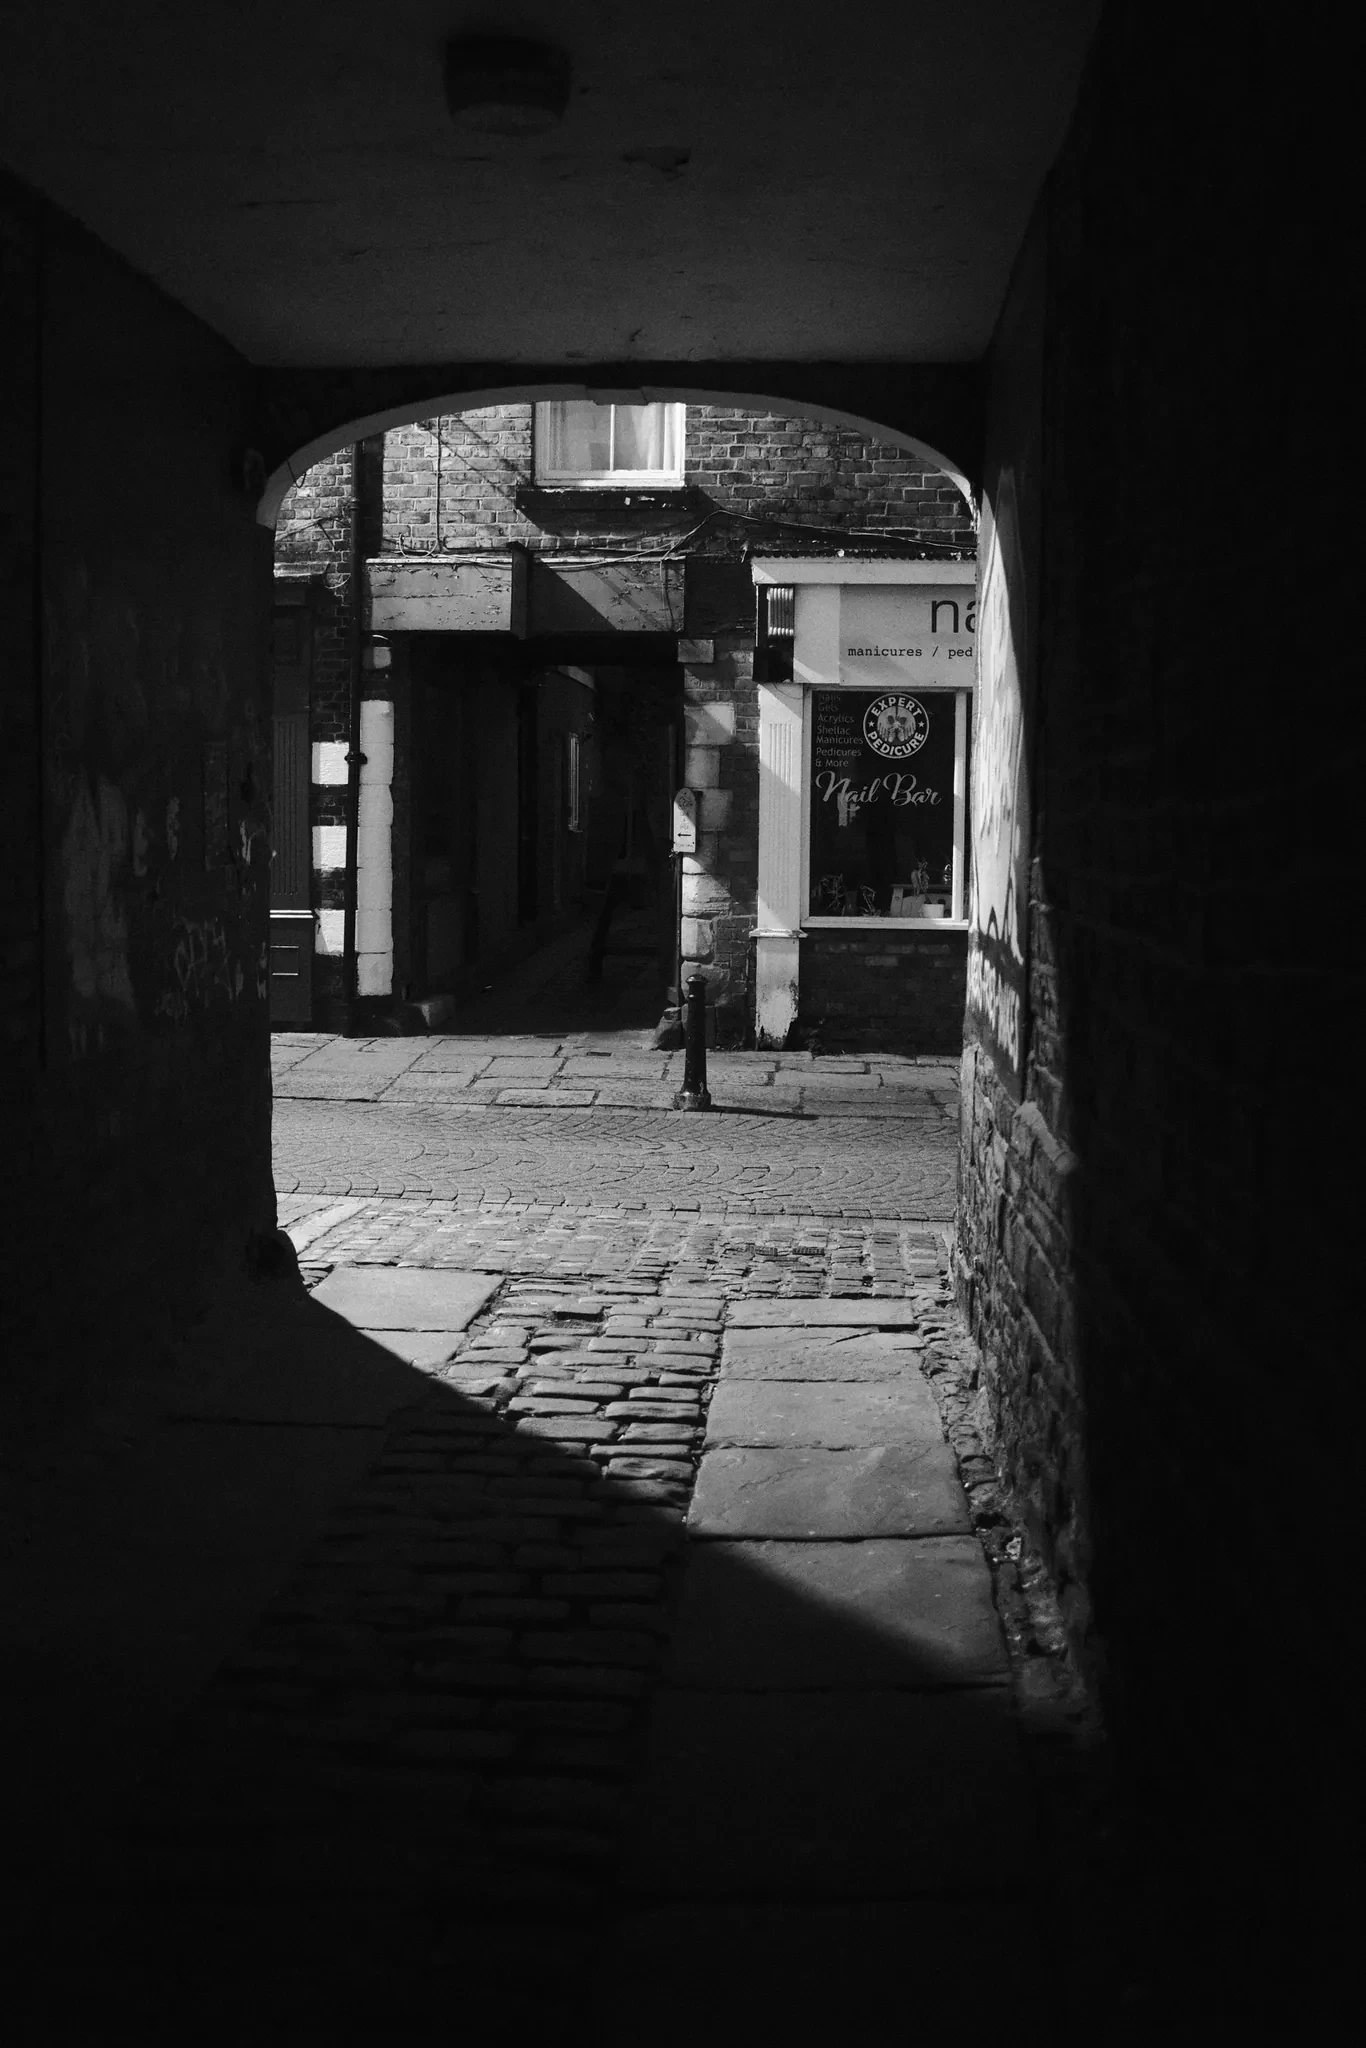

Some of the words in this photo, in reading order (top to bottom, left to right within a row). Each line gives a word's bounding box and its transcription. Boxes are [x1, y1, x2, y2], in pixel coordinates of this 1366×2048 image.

[847, 645, 923, 657] manicures
[948, 646, 973, 659] ped
[871, 697, 922, 717] EXPERT
[817, 713, 855, 724] Acrylics
[816, 725, 851, 735] Shellac
[816, 735, 864, 744] Manicures
[867, 732, 925, 756] PEDICURE
[816, 747, 862, 757] Pedicures
[825, 759, 849, 767] More
[815, 770, 881, 812] Nail
[883, 772, 942, 806] Bar
